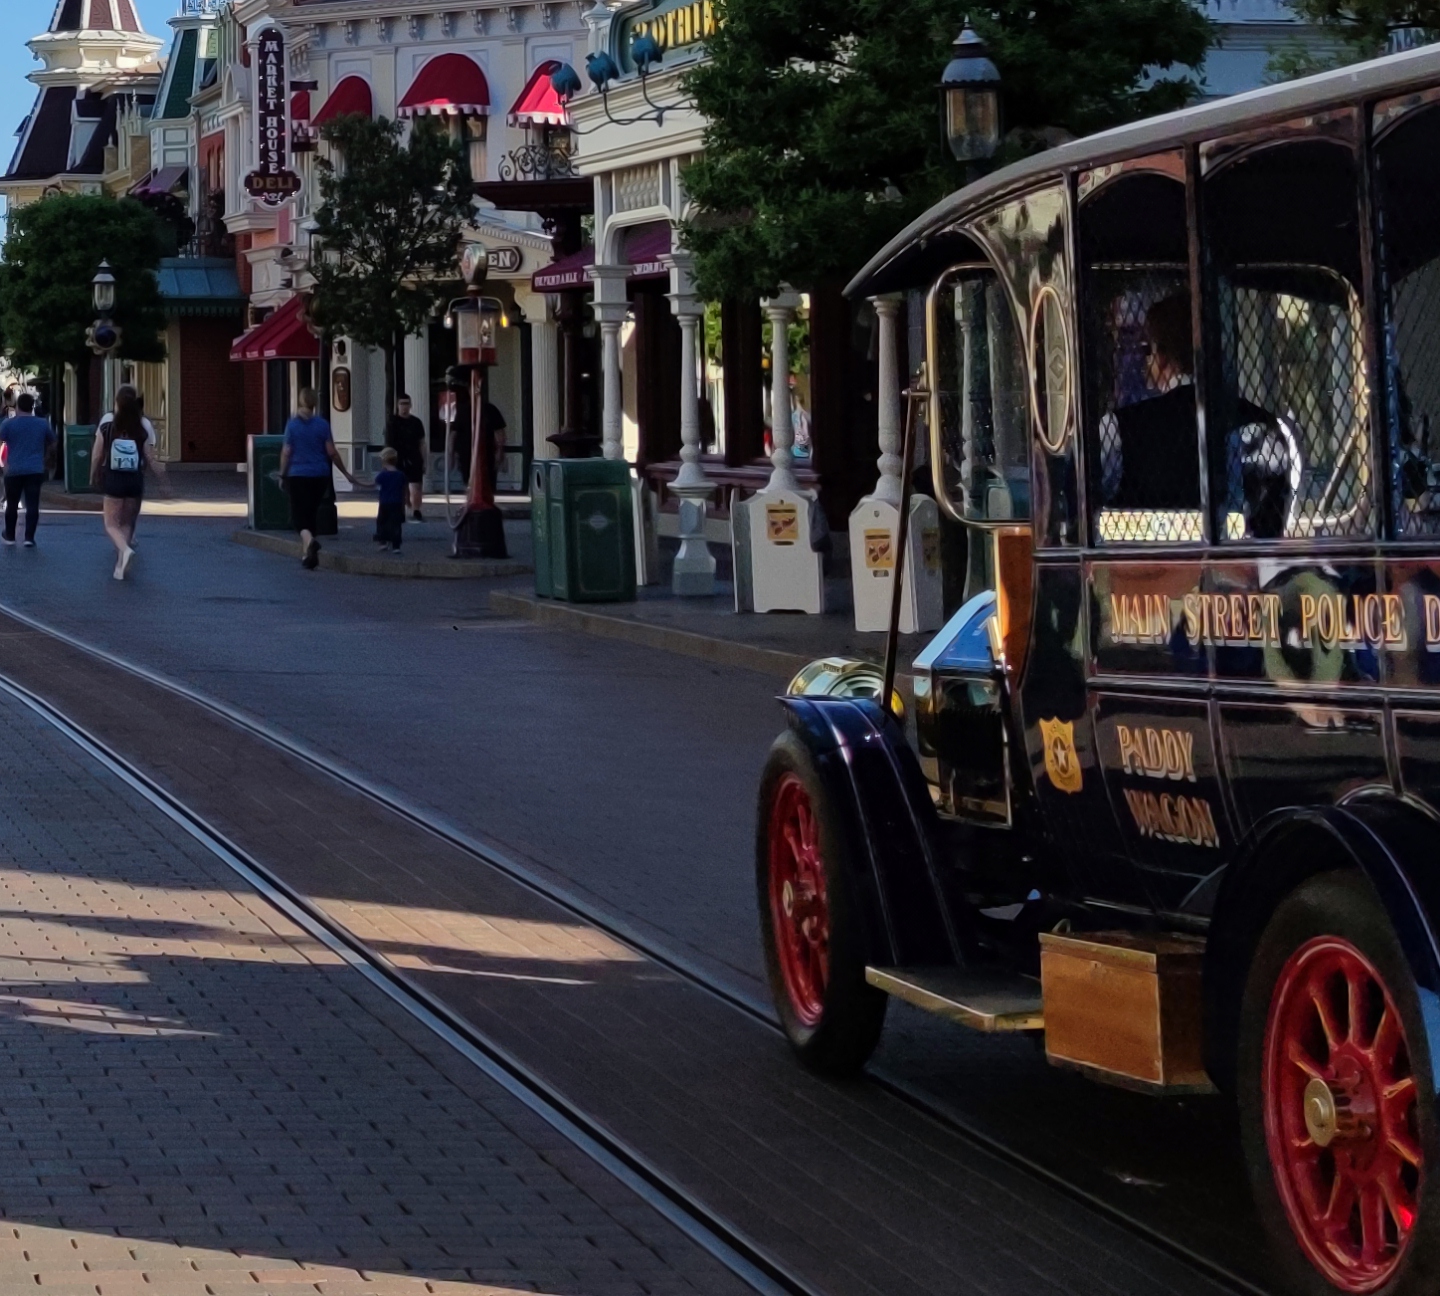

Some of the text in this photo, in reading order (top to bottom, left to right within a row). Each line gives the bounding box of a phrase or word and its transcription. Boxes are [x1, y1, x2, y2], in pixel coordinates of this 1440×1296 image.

[264, 40, 280, 175] MARKET HOUSE
[251, 176, 294, 190] DELI
[488, 250, 512, 268] EN
[534, 271, 578, 288] DEPENDABLE
[1110, 592, 1170, 641] MAIN
[1185, 592, 1281, 643] STREET
[1299, 593, 1406, 648] POLICE
[1116, 724, 1195, 780] PADDY
[1123, 787, 1218, 847] WAGON
